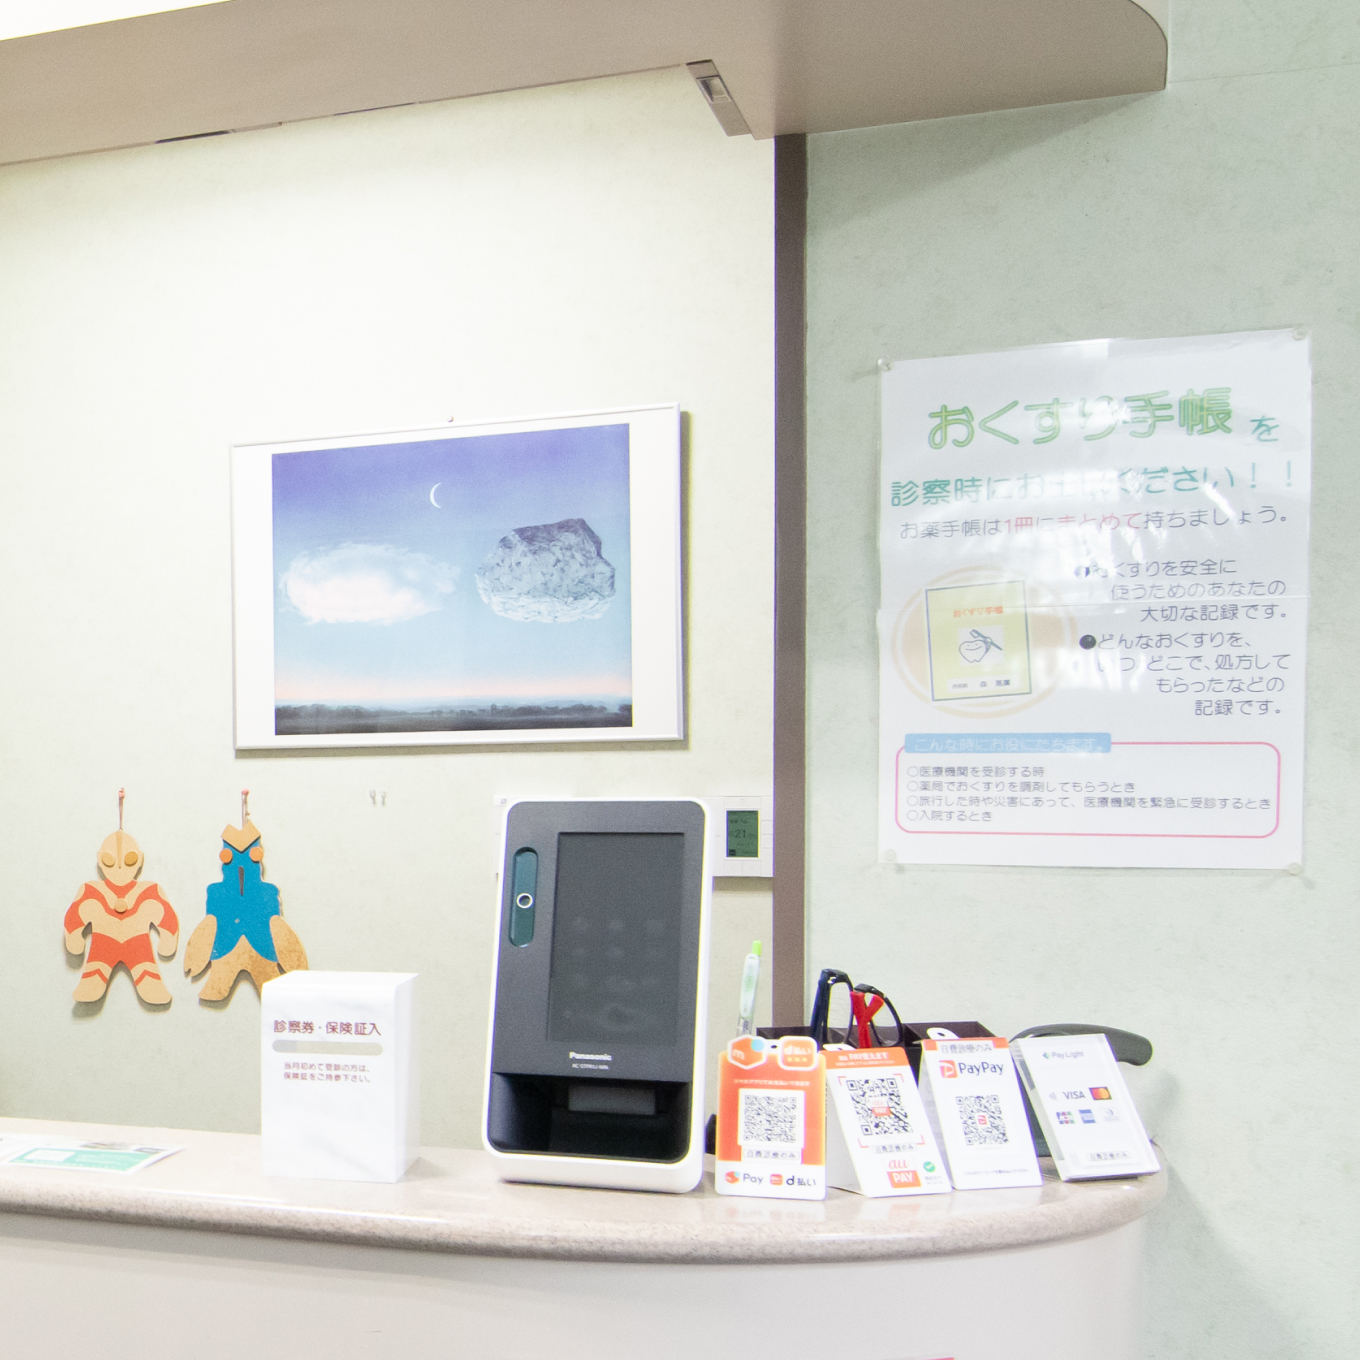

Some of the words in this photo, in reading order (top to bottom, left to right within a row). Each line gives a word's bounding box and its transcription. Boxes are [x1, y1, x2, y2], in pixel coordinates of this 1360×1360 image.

[1250, 415, 1280, 442] を
[1111, 580, 1286, 600] 使うためのあなたの
[1140, 604, 1287, 622] 大切な記録です。
[1097, 632, 1251, 650] どんなおくすりを、
[1098, 654, 1291, 672] いつどこで、処方して
[1156, 677, 1285, 693] もらったなどの
[1195, 700, 1281, 716] 記録です。
[919, 766, 1044, 778] 医療機関を受診する時
[919, 781, 1135, 793] 薬局でおくすりを調剤してもらうとき
[919, 810, 992, 822] 入院するとき
[274, 1020, 381, 1036] 診察券・保険証入
[941, 1044, 993, 1054] 自費診療のみ
[569, 1052, 612, 1062] Panasonic
[284, 1062, 370, 1073] 当月初めて受診の方は、
[958, 1061, 1004, 1076] PayPay
[284, 1072, 371, 1083] 保険証をご持参下さい。
[1062, 1091, 1086, 1099] VISA
[889, 1160, 908, 1169] au
[743, 1173, 763, 1184] Pay
[892, 1172, 914, 1183] PAY
